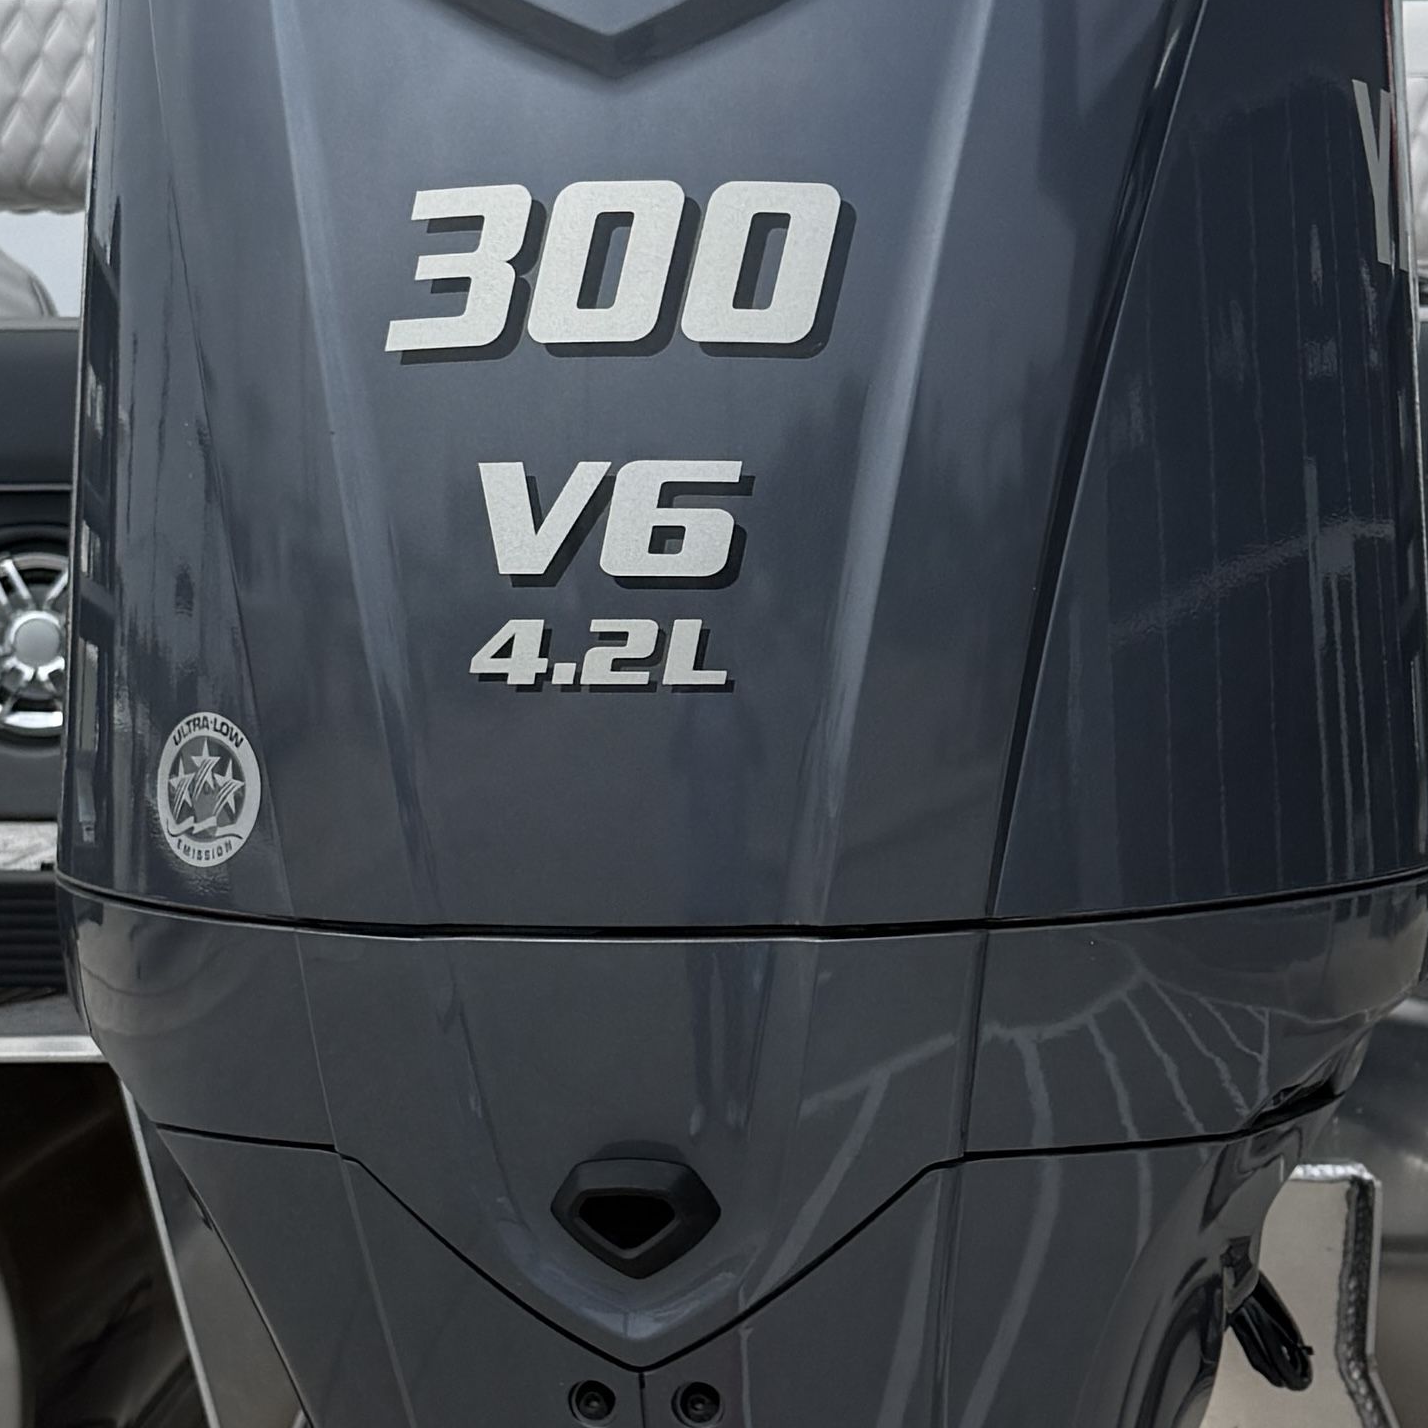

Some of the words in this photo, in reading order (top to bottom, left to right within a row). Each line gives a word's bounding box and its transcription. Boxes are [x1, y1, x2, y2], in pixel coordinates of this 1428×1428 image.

[385, 180, 856, 360] 300
[478, 460, 755, 589] V6
[469, 619, 735, 693] 4.2L
